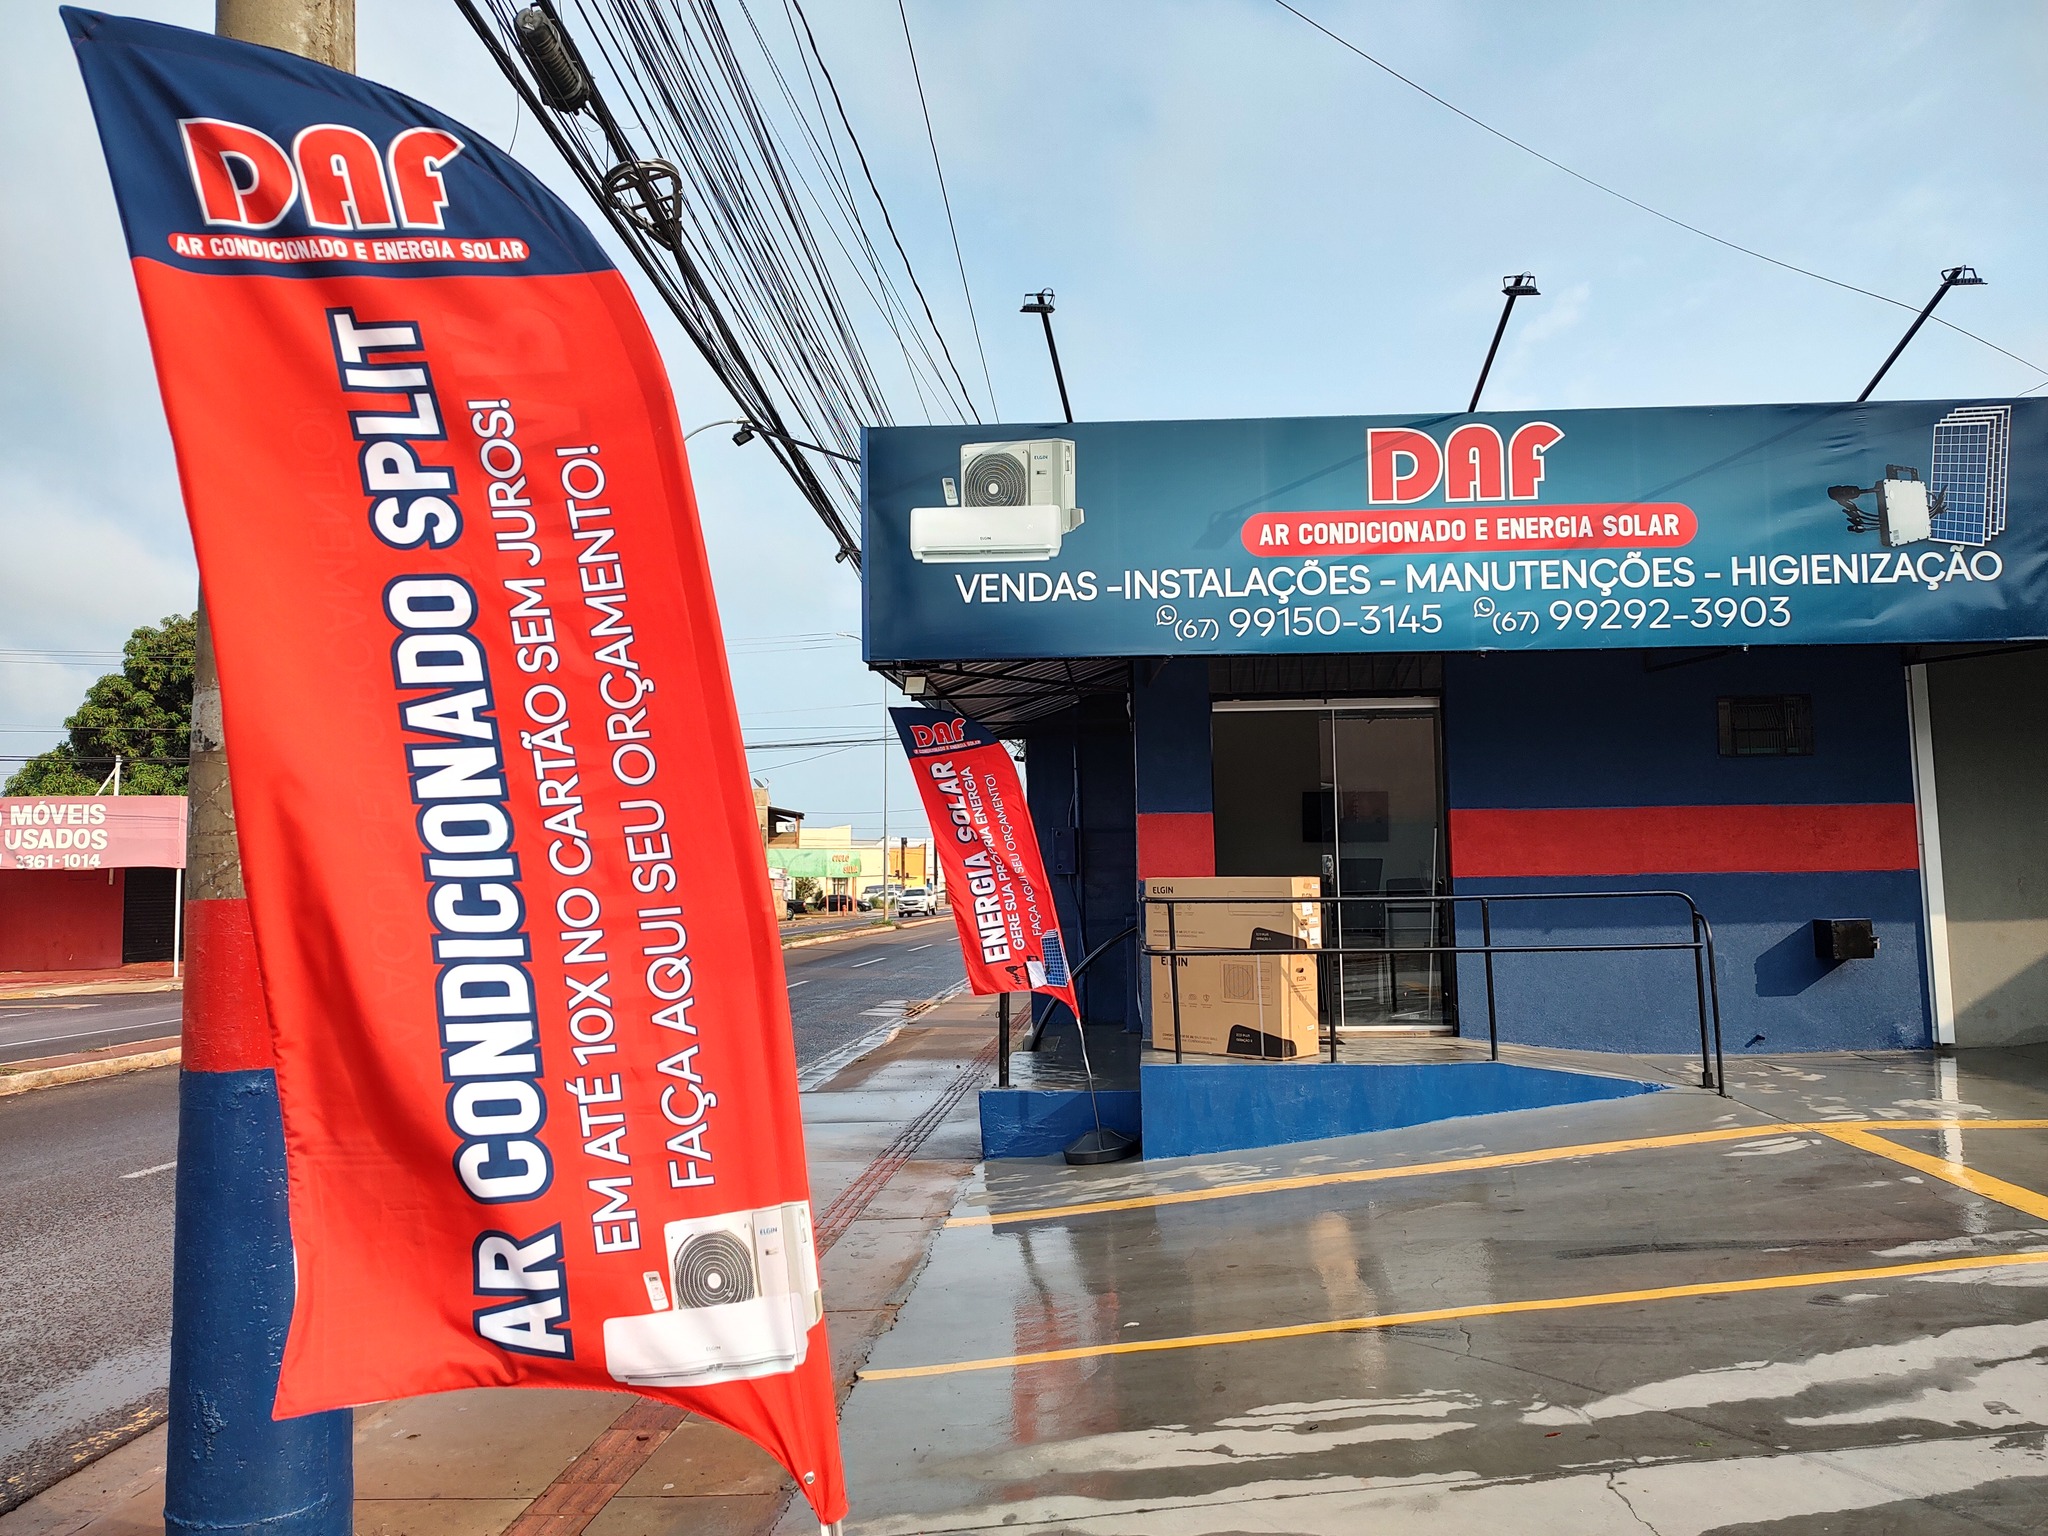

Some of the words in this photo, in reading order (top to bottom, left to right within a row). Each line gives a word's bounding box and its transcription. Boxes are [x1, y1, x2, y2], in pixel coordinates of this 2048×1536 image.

[179, 117, 465, 231] DAF
[176, 236, 204, 257] AR
[210, 237, 348, 261] CONDICIONADO
[354, 241, 367, 260] E
[373, 240, 455, 261] ENERGIA
[461, 241, 525, 260] SOLAR
[333, 314, 457, 545] SPLIT
[1366, 422, 1566, 505] DAF
[468, 399, 541, 567] JUROS!
[1259, 524, 1290, 546] AR
[1298, 520, 1466, 545] CONDICIONADO
[1475, 518, 1488, 541] E
[1496, 516, 1594, 540] ENERGIA
[1602, 514, 1679, 537] SOLAR
[954, 570, 1098, 604] VENDAS
[1406, 550, 1696, 597] MANUTENÇÕES
[1731, 545, 2003, 591] HIGIENIZAÇÃO
[505, 579, 559, 673] SEM
[556, 445, 656, 785] ORÇAMENTO!
[1174, 618, 1219, 642] (67)
[1229, 604, 1443, 638] 99150-3145
[1492, 610, 1540, 635] (67)
[1549, 596, 1791, 631] 99292-3903
[909, 718, 967, 748] DAF
[10, 801, 107, 826] MÓVEIS
[521, 685, 592, 876] CARTÃO
[931, 761, 978, 843] SOLAR
[960, 766, 988, 825] ENERGIA
[984, 773, 1017, 851] ORÇAMENTO!
[4, 828, 109, 850] USADOS
[620, 800, 676, 893] SEU
[979, 826, 1011, 882] PRÓPRIA
[1009, 854, 1025, 874] SEU
[388, 579, 547, 1198] CONDICIONADO
[557, 888, 607, 963] NO
[964, 850, 1011, 964] ENERGIA
[1001, 882, 1017, 911] SUA
[1021, 876, 1036, 903] AQUI
[1028, 905, 1042, 936] FAÇA
[1152, 886, 1174, 895] ELGIN
[638, 907, 697, 1034] AQUI
[1007, 913, 1026, 951] GERE
[566, 973, 616, 1065] 10X
[566, 1075, 630, 1165] ATÉ
[656, 1046, 717, 1188] FAÇA
[589, 1177, 640, 1254] EM
[759, 1227, 778, 1236] ELGIN
[479, 1234, 566, 1353] AR
